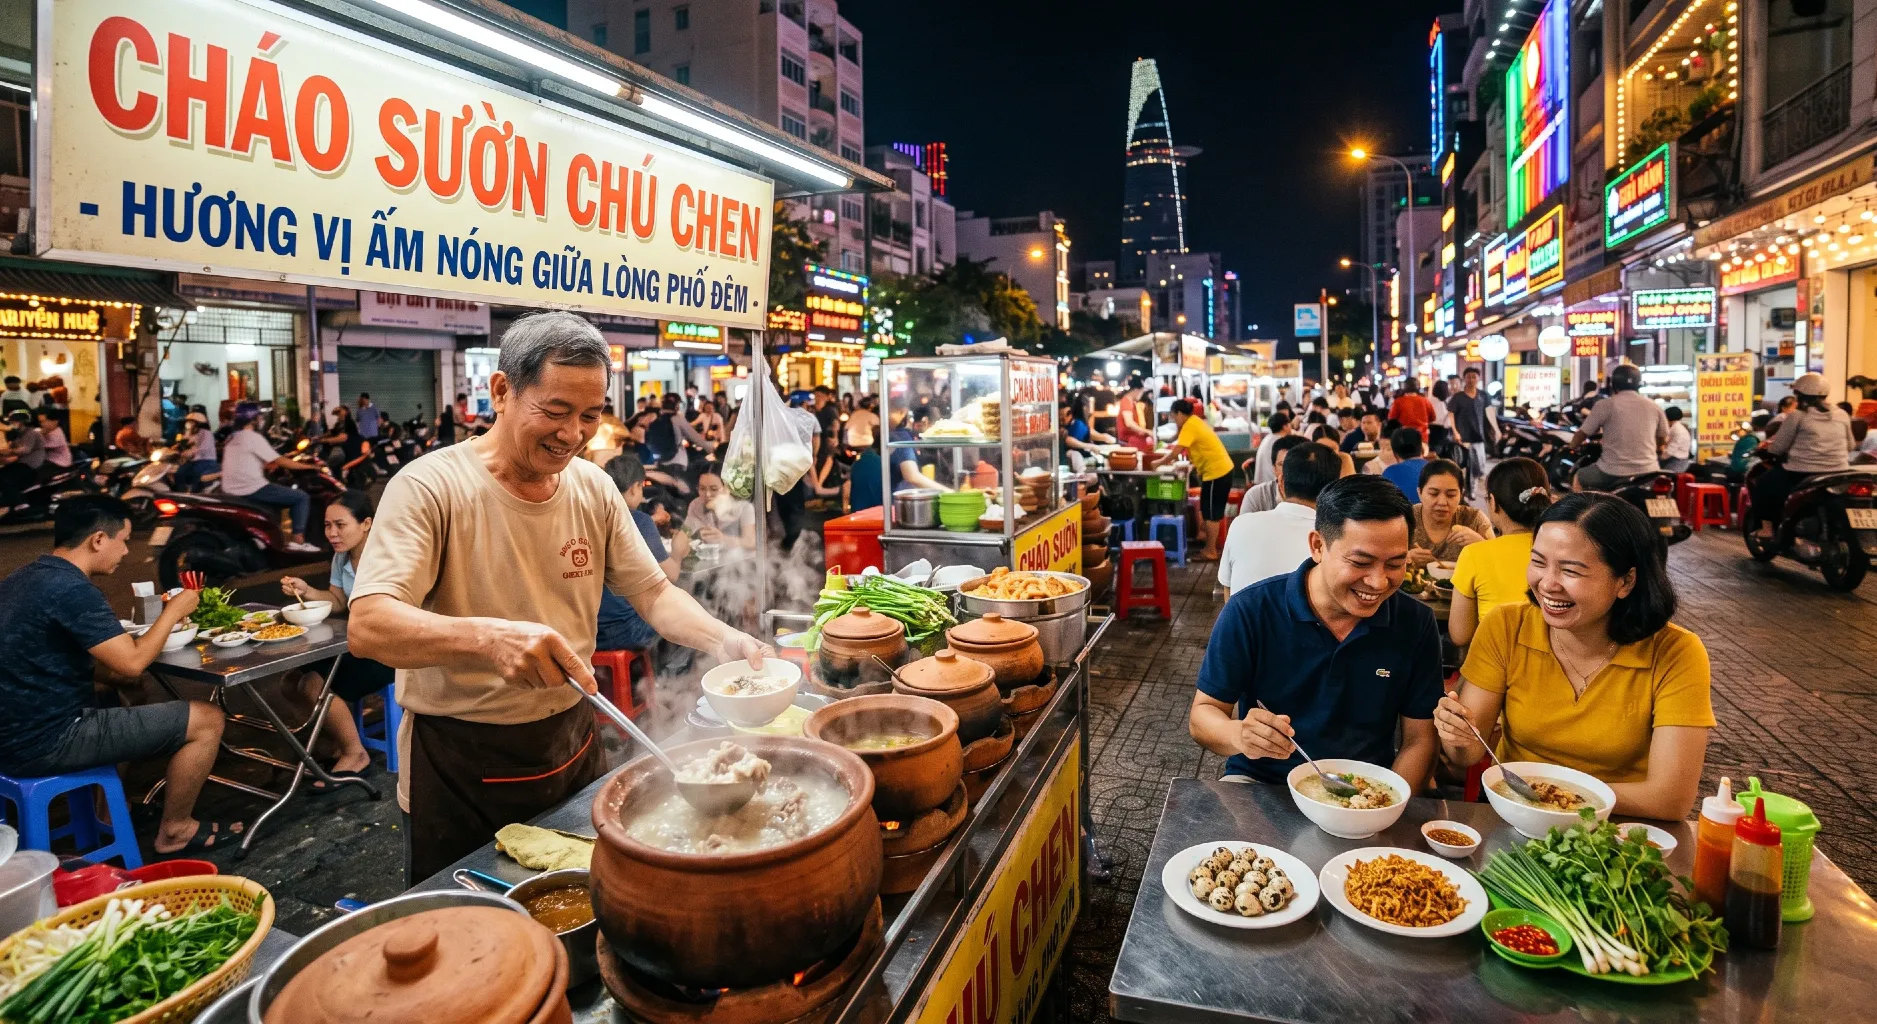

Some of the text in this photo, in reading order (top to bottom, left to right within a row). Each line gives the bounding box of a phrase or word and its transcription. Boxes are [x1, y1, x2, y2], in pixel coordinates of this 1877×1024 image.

[88, 16, 762, 262] CHÁO SƯỜN CHÚ CHEN
[121, 180, 298, 257] HƯƠNG
[312, 212, 352, 276] VỊ
[365, 206, 424, 273] ẤM
[437, 226, 523, 287] NÓNG
[532, 244, 594, 295] GIỮA
[601, 254, 660, 303] LÒNG
[666, 265, 710, 309] PHỐ
[710, 274, 749, 314] ĐÊM
[1019, 534, 1050, 571] CHÁO
[1010, 789, 1075, 977] CHEN
